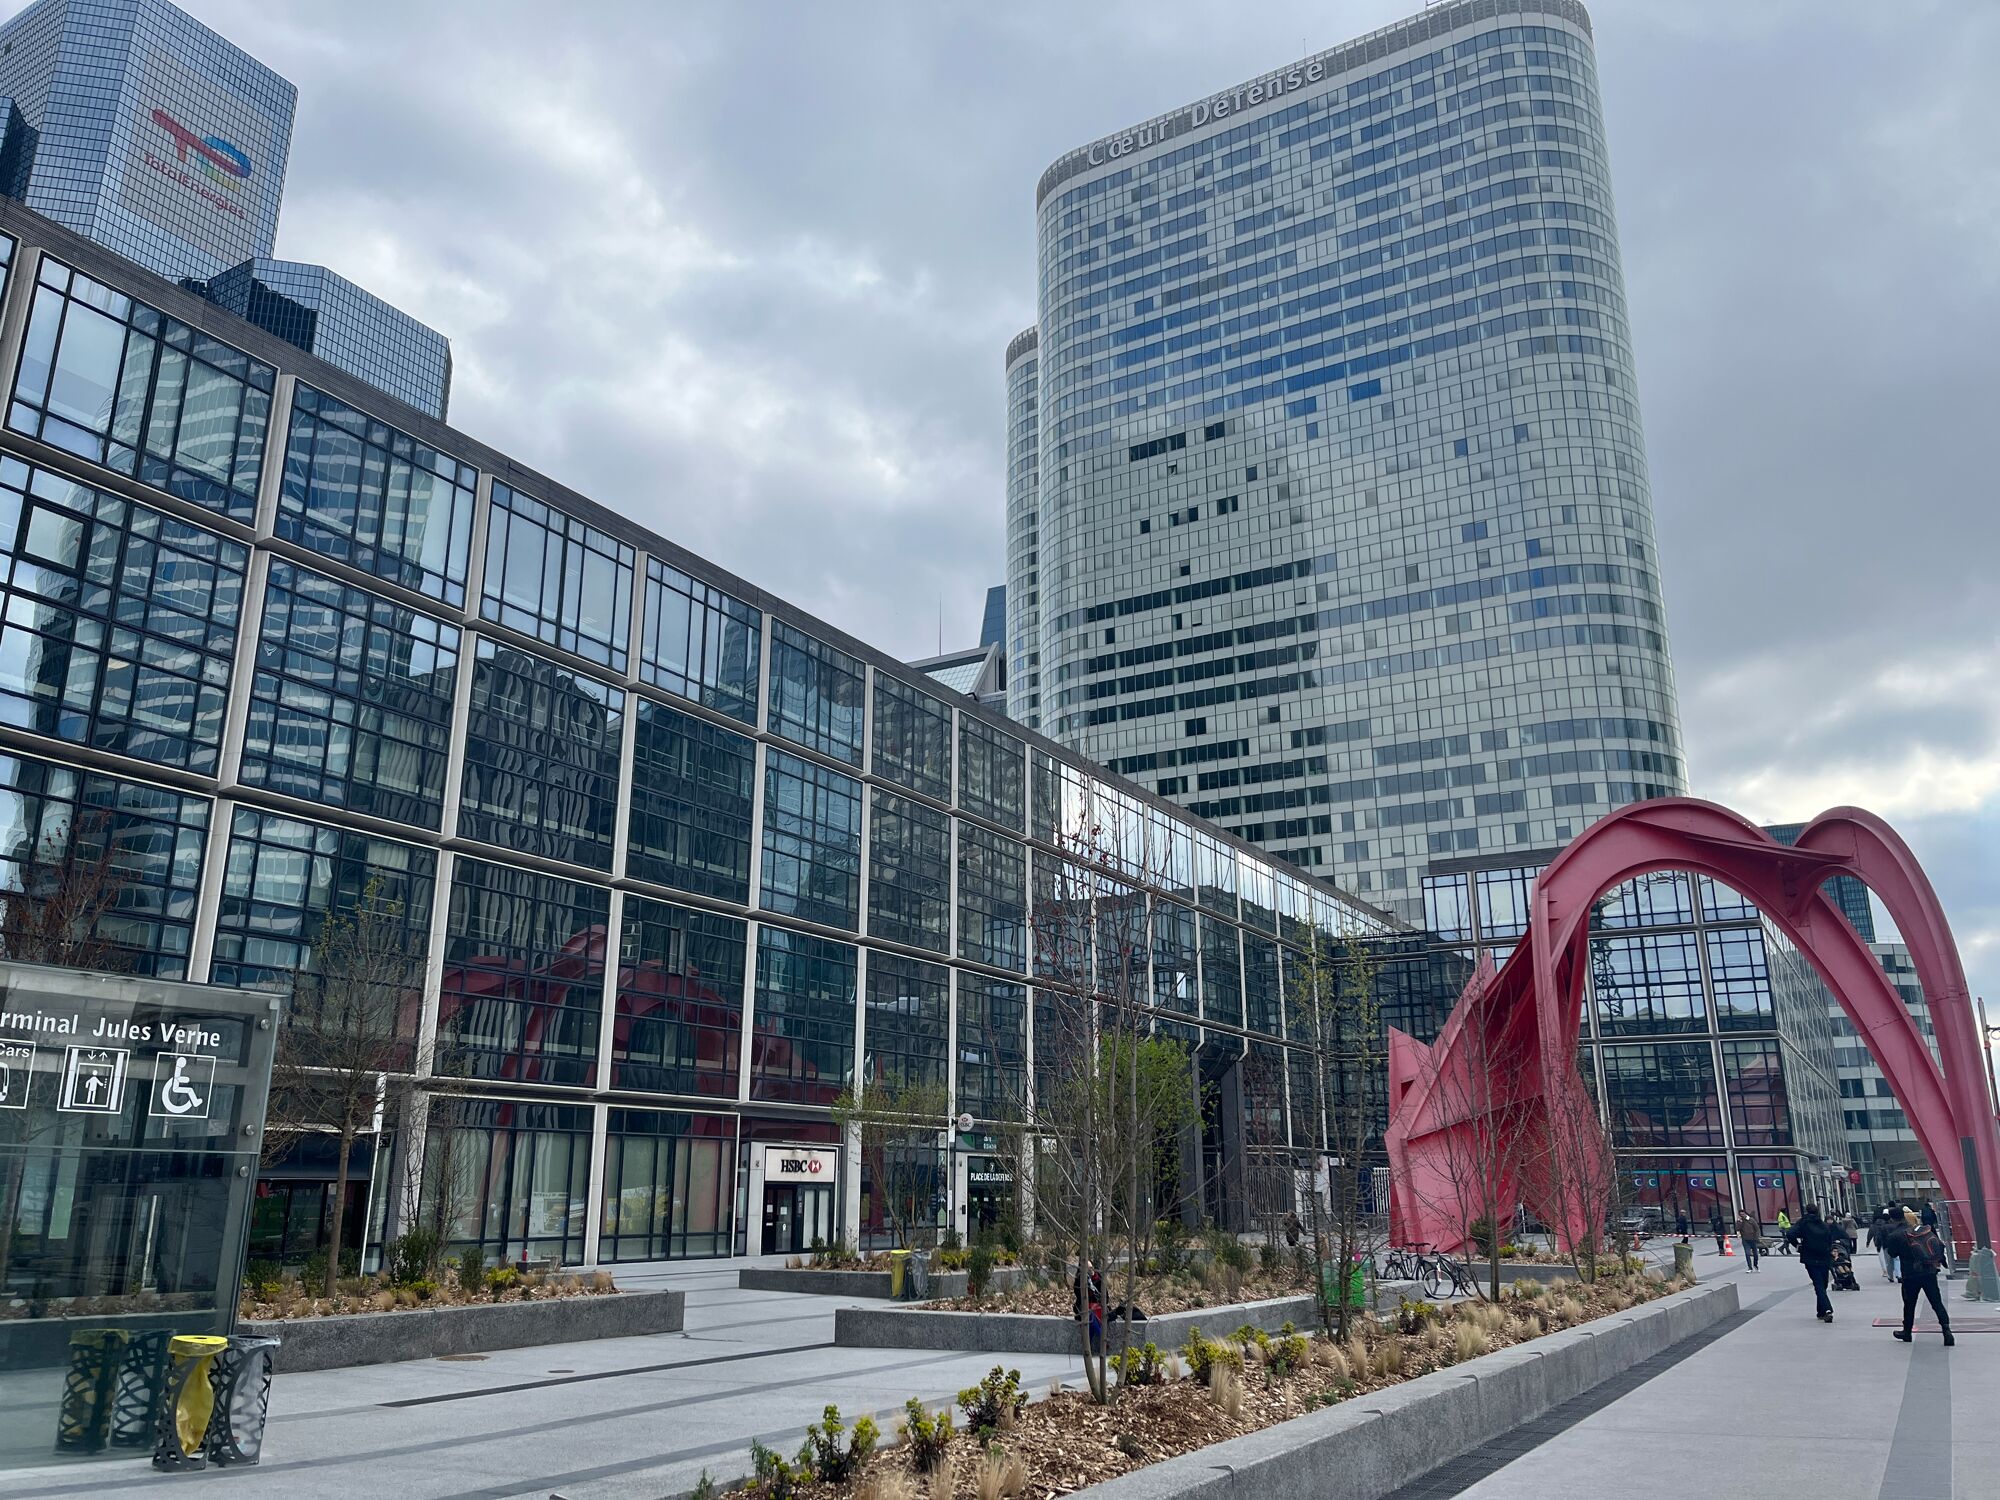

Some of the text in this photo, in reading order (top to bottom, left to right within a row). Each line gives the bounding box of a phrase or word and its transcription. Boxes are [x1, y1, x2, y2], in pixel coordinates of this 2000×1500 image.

[1088, 61, 1323, 165] Cœur Défense
[144, 151, 246, 219] TotalEnergies
[0, 1010, 220, 1046] rminal Jules Verne
[781, 1159, 807, 1172] HSBC
[971, 1172, 983, 1181] PLACE
[984, 1172, 990, 1181] DE
